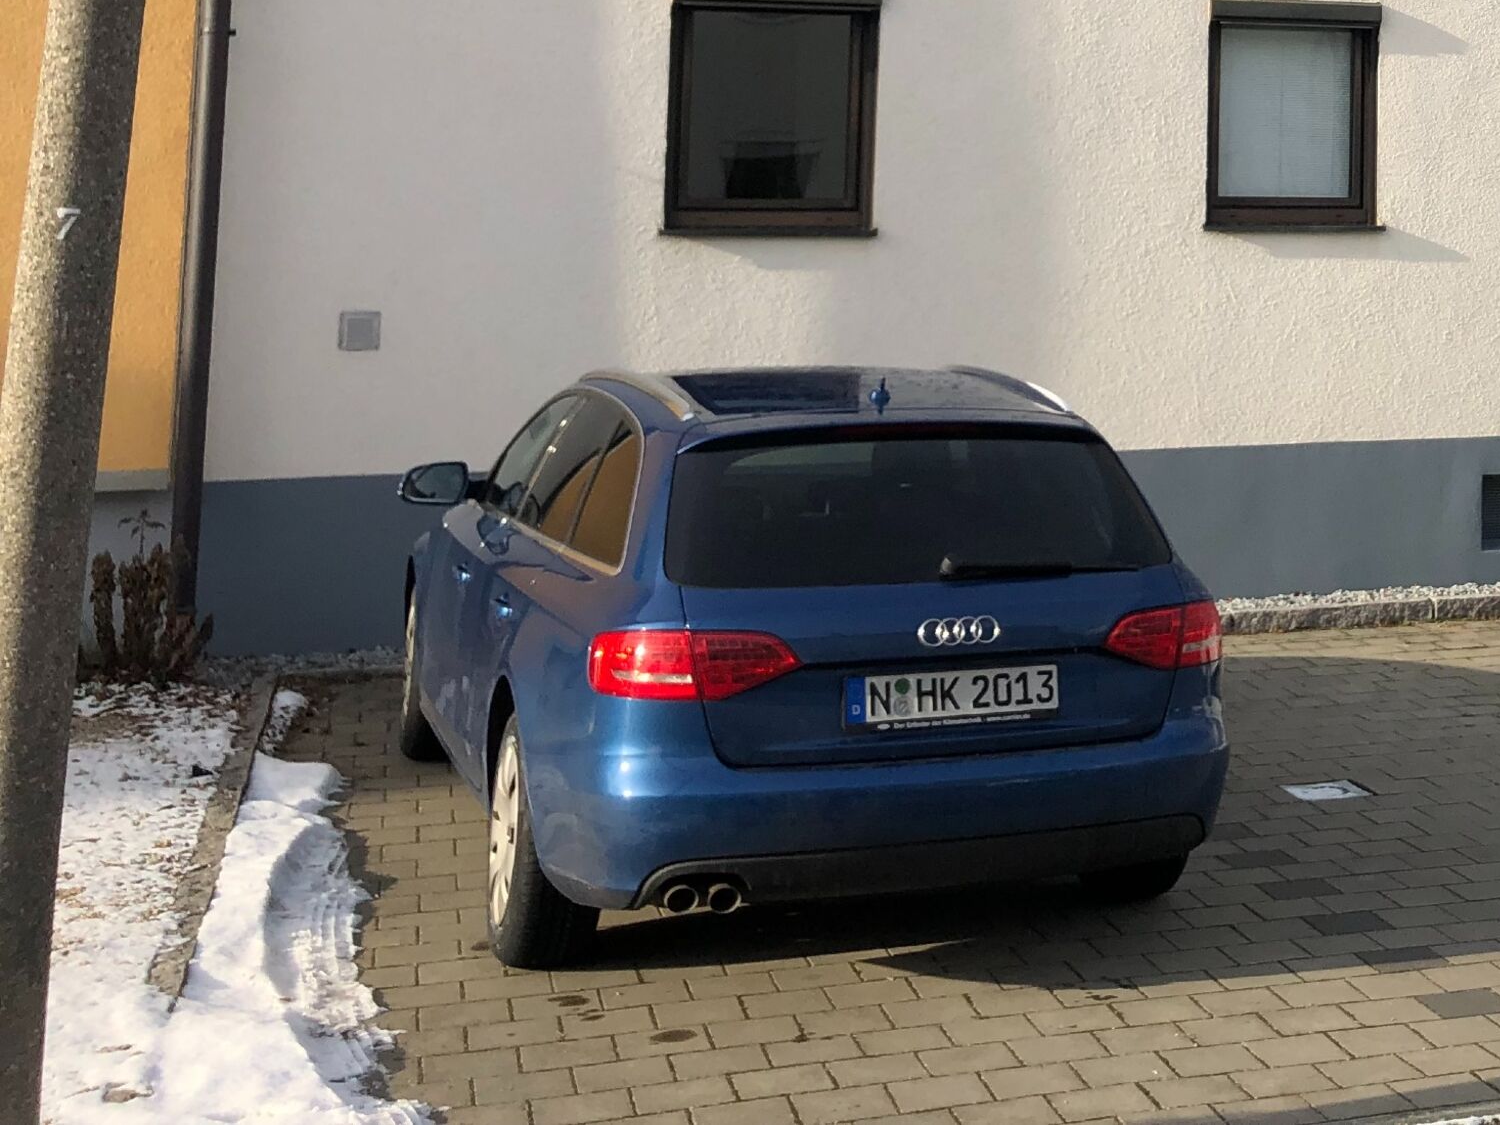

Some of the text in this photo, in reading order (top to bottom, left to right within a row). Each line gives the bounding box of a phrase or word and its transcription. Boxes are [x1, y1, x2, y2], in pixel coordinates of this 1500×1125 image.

[56, 208, 81, 240] 7
[869, 670, 1054, 717] N HK 2013
[851, 704, 861, 716] D
